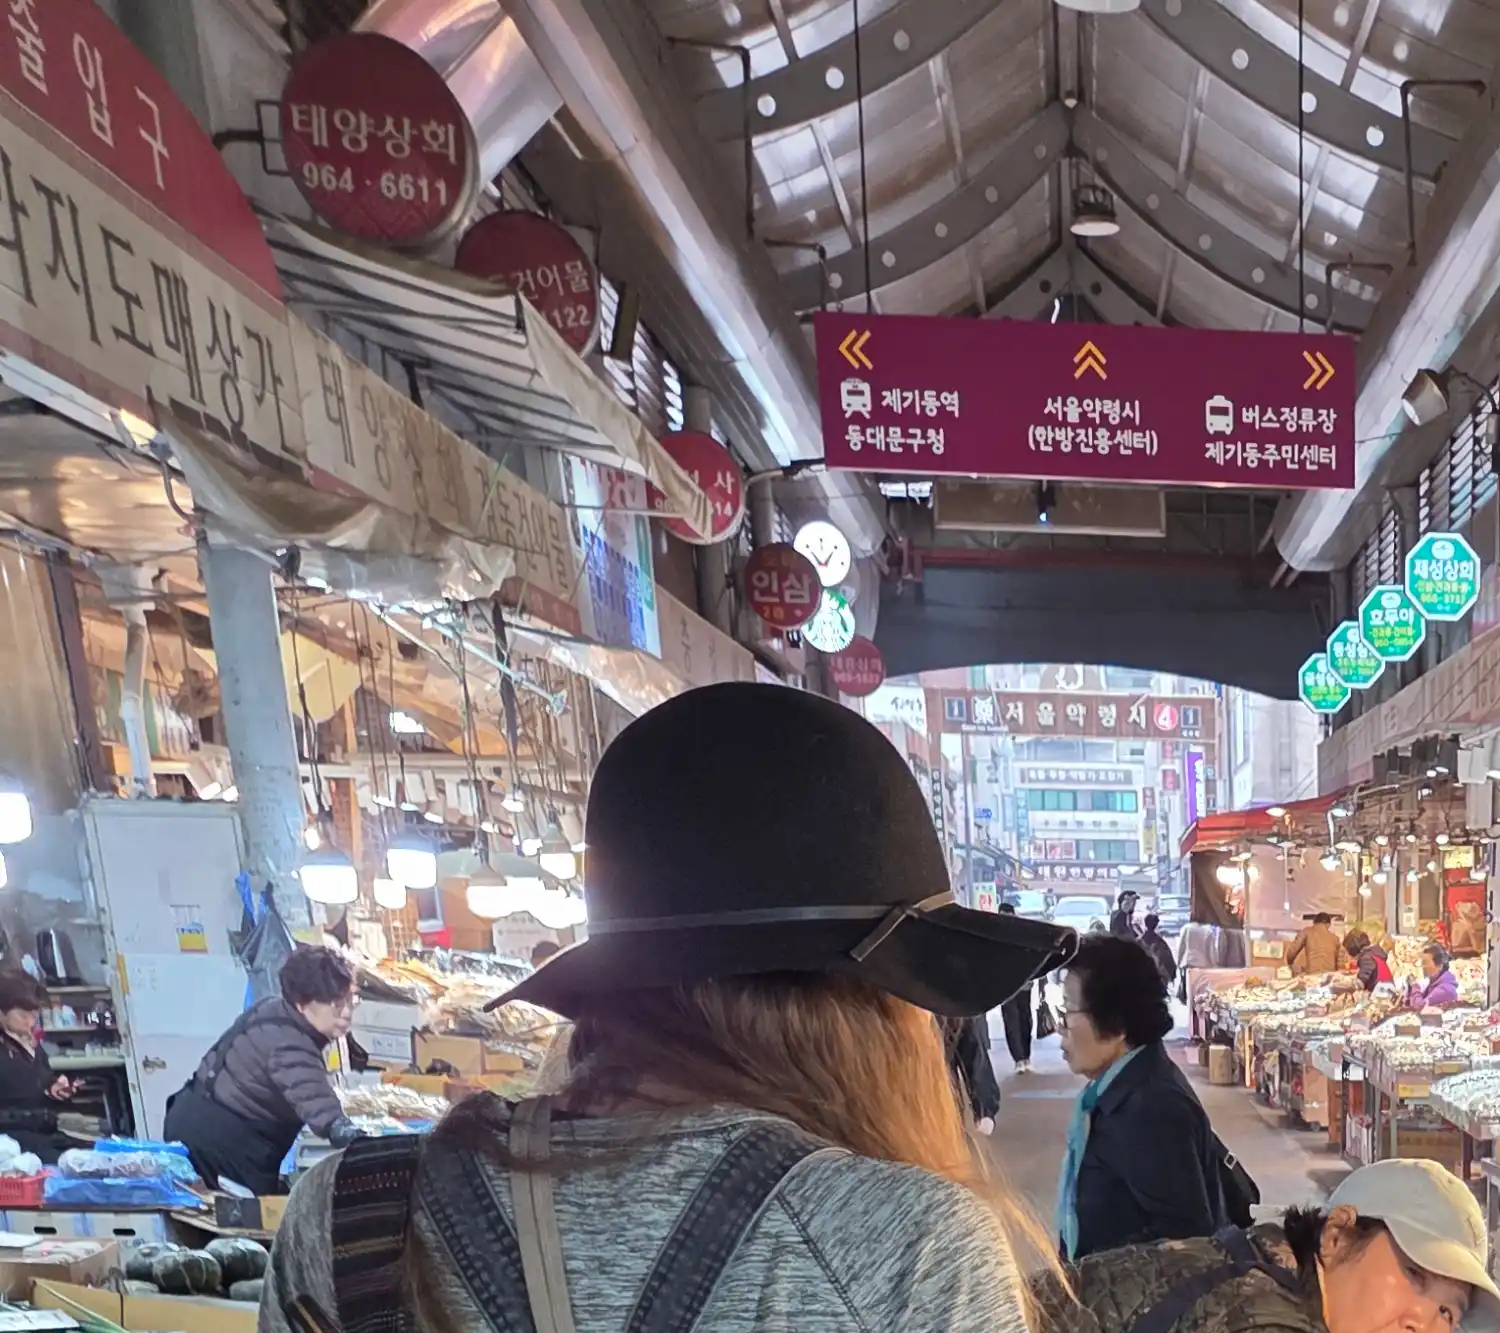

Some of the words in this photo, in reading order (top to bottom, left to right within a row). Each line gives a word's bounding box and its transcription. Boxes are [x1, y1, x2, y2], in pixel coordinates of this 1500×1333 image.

[289, 104, 457, 165] 태양상회
[490, 260, 590, 300] 건어물
[881, 387, 960, 418] 제기동역
[1043, 395, 1140, 427] 서울약령시
[1241, 404, 1338, 434] 버스정류장
[844, 424, 945, 455] 동대문구청
[1028, 424, 1159, 456] (한방진흥센터)
[1204, 440, 1337, 471] 제기동주민센터
[752, 570, 812, 604] 인삼
